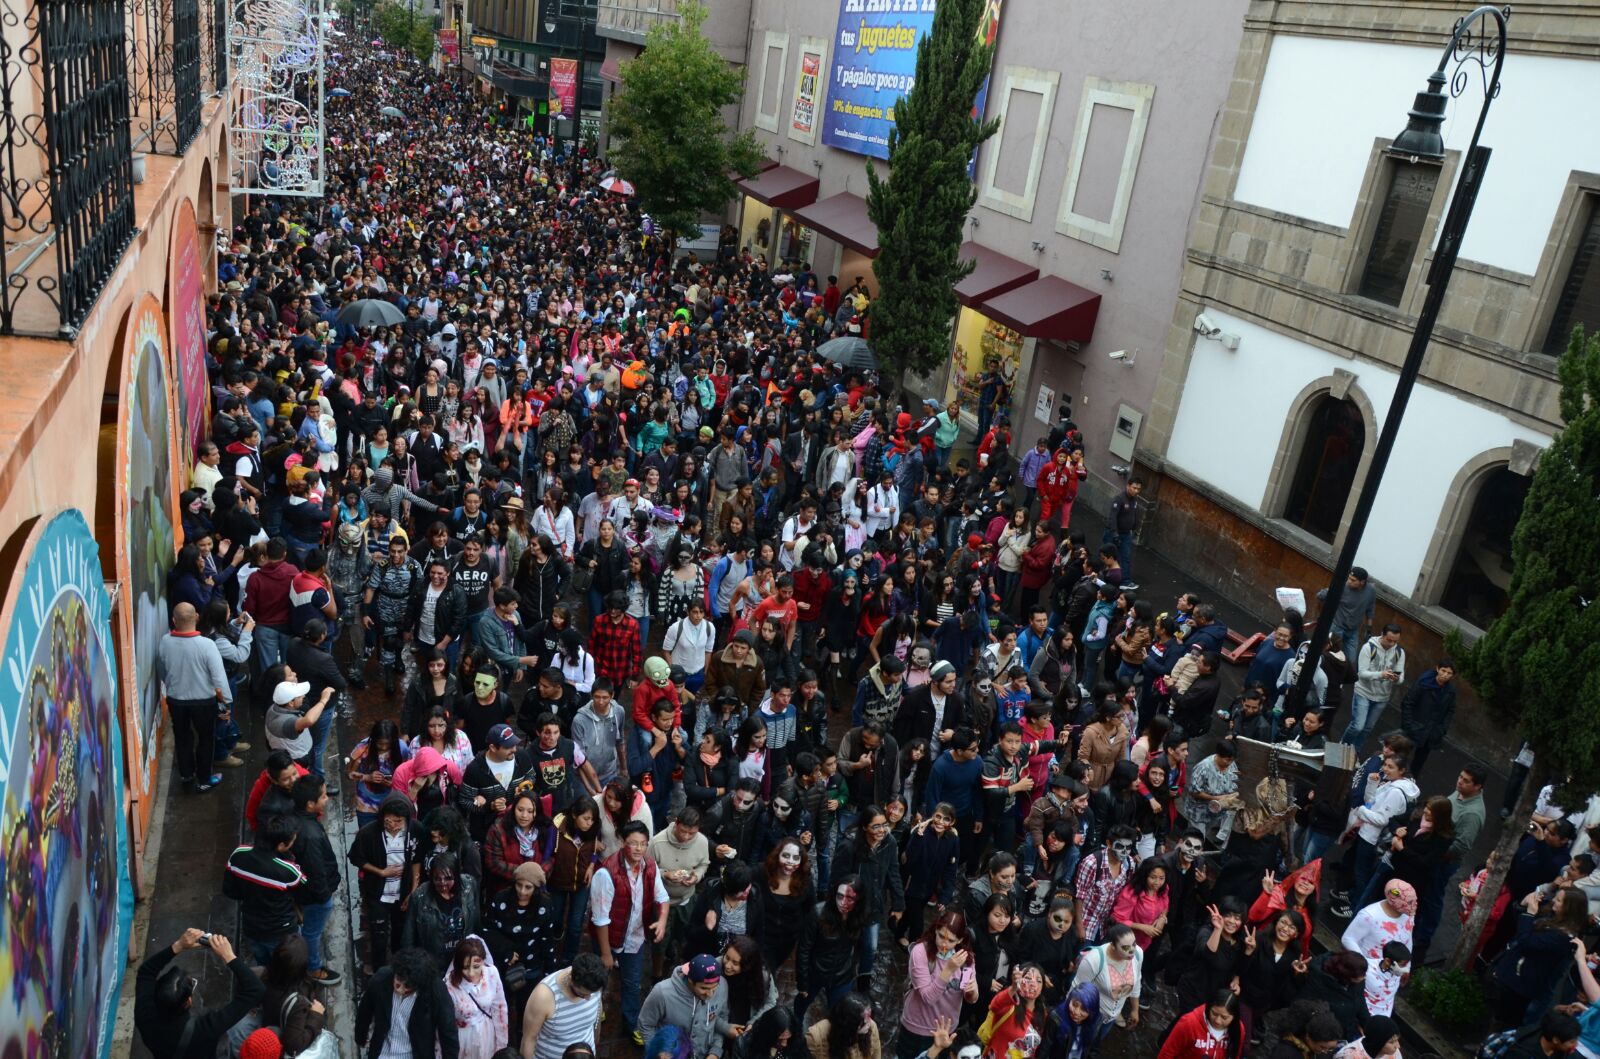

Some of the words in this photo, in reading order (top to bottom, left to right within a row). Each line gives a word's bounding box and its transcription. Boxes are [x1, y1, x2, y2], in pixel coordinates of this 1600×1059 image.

[841, 30, 855, 46] tus
[855, 18, 916, 54] juguetes
[837, 65, 844, 82] Y
[842, 66, 876, 88] págalos
[875, 74, 899, 91] poco
[899, 75, 905, 90] a
[845, 101, 853, 114] de
[455, 571, 488, 581] AERO
